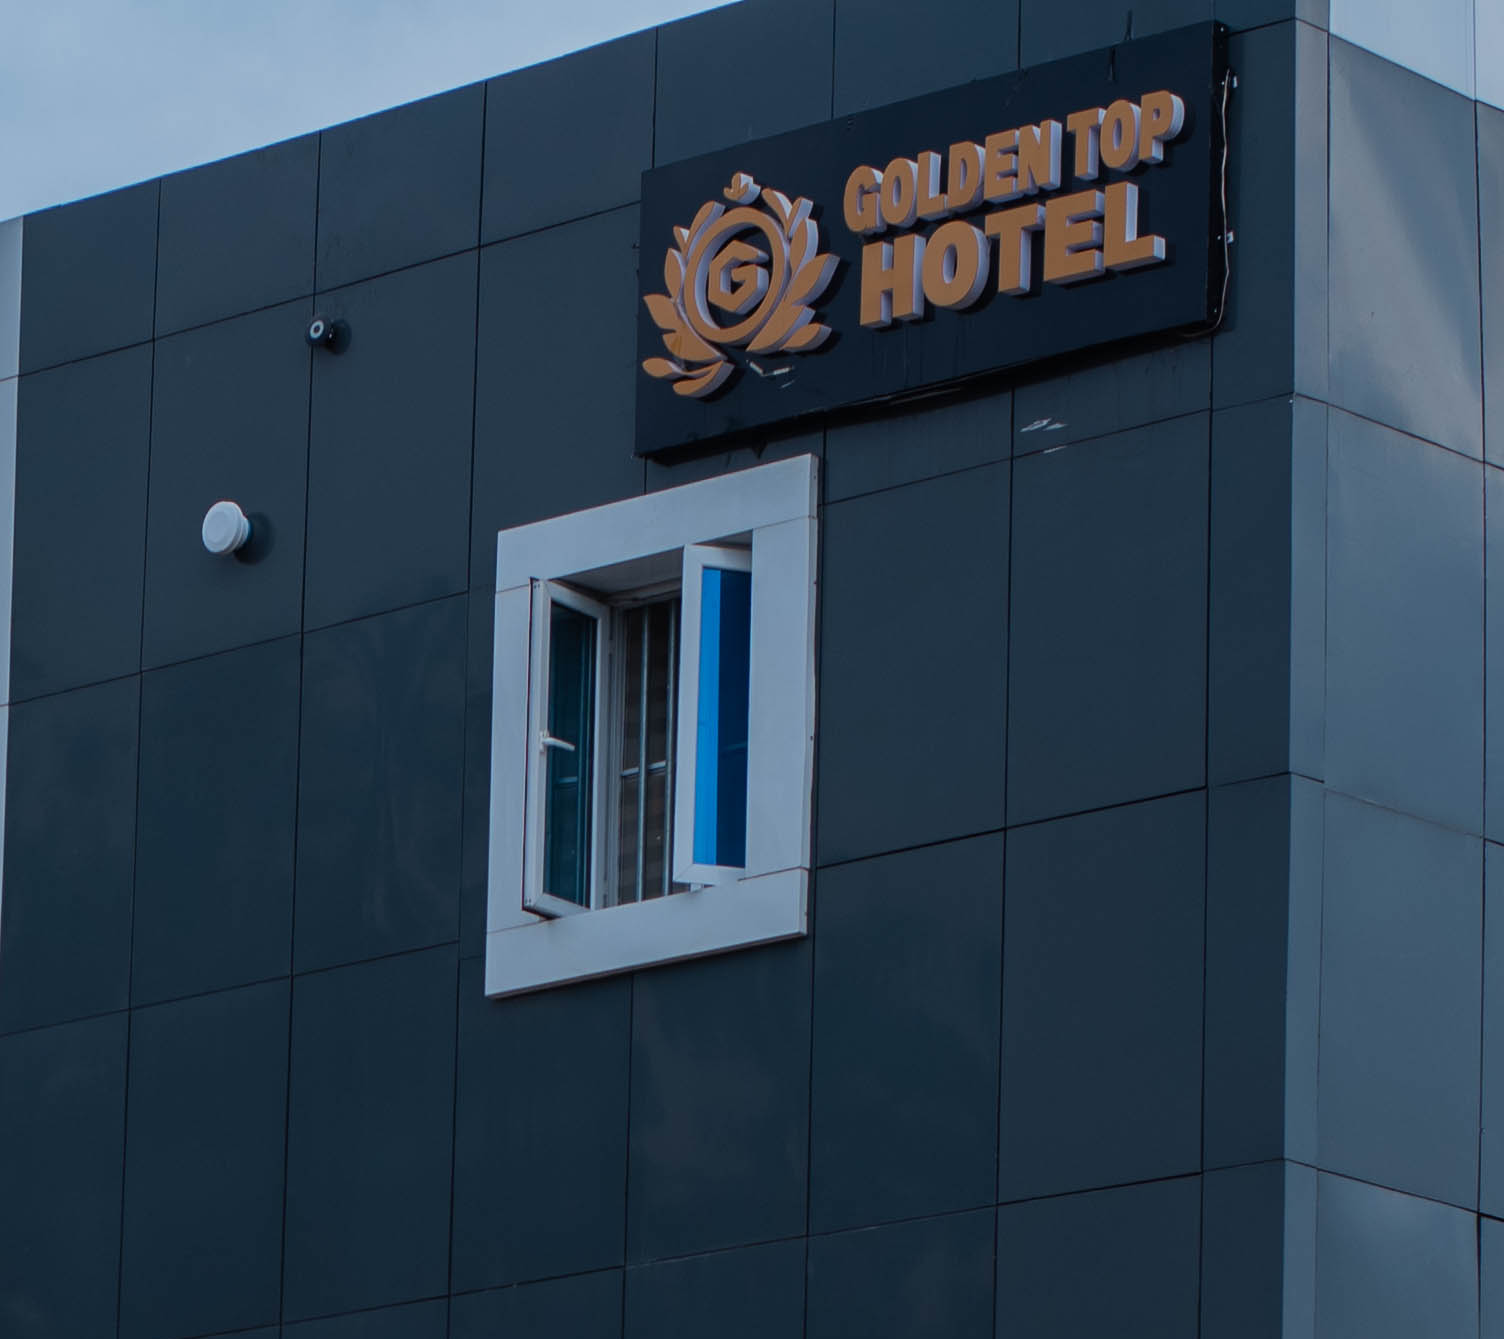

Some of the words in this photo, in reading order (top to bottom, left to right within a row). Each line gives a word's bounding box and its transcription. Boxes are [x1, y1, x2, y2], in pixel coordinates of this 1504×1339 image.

[843, 120, 1061, 236] GOLDEN
[1067, 90, 1184, 180] TOP
[708, 239, 769, 314] G
[859, 181, 1166, 329] HOTEL
